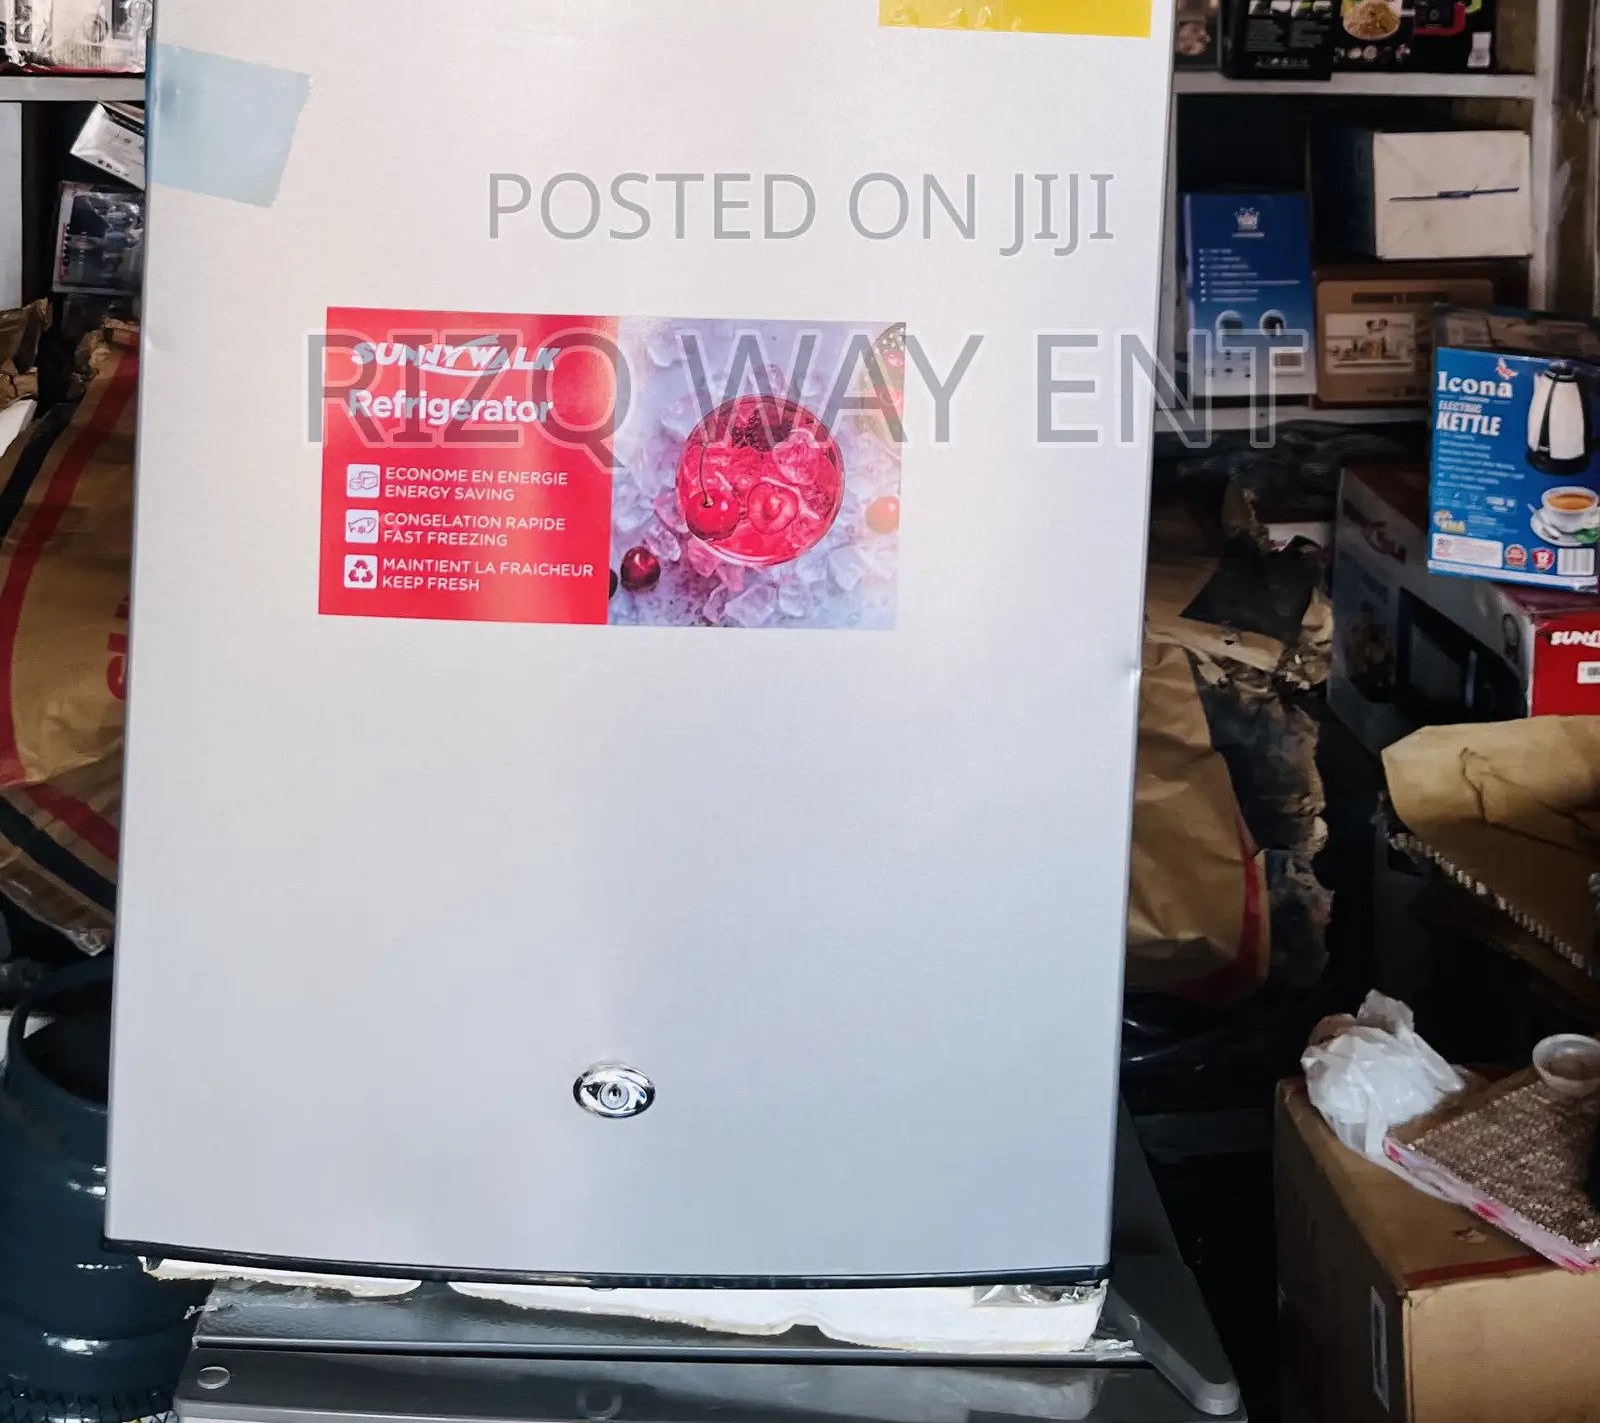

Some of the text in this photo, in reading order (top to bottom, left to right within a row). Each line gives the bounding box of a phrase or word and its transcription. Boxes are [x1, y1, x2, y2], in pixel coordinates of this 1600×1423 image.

[1437, 371, 1513, 398] Icona
[349, 388, 554, 426] Refrigerator
[1439, 400, 1482, 414] ELECTRIC
[1436, 411, 1502, 437] KETTLE
[385, 466, 568, 486] ECONOME EN ENERGIE
[385, 485, 515, 501] ENERGY SAVING
[384, 512, 566, 531] CONGELATION RAPIDE
[383, 530, 508, 547] FAST FREEZING
[382, 558, 594, 577] MAINTIENT LA FRAICHEUR
[382, 576, 480, 591] KEEP FRESH
